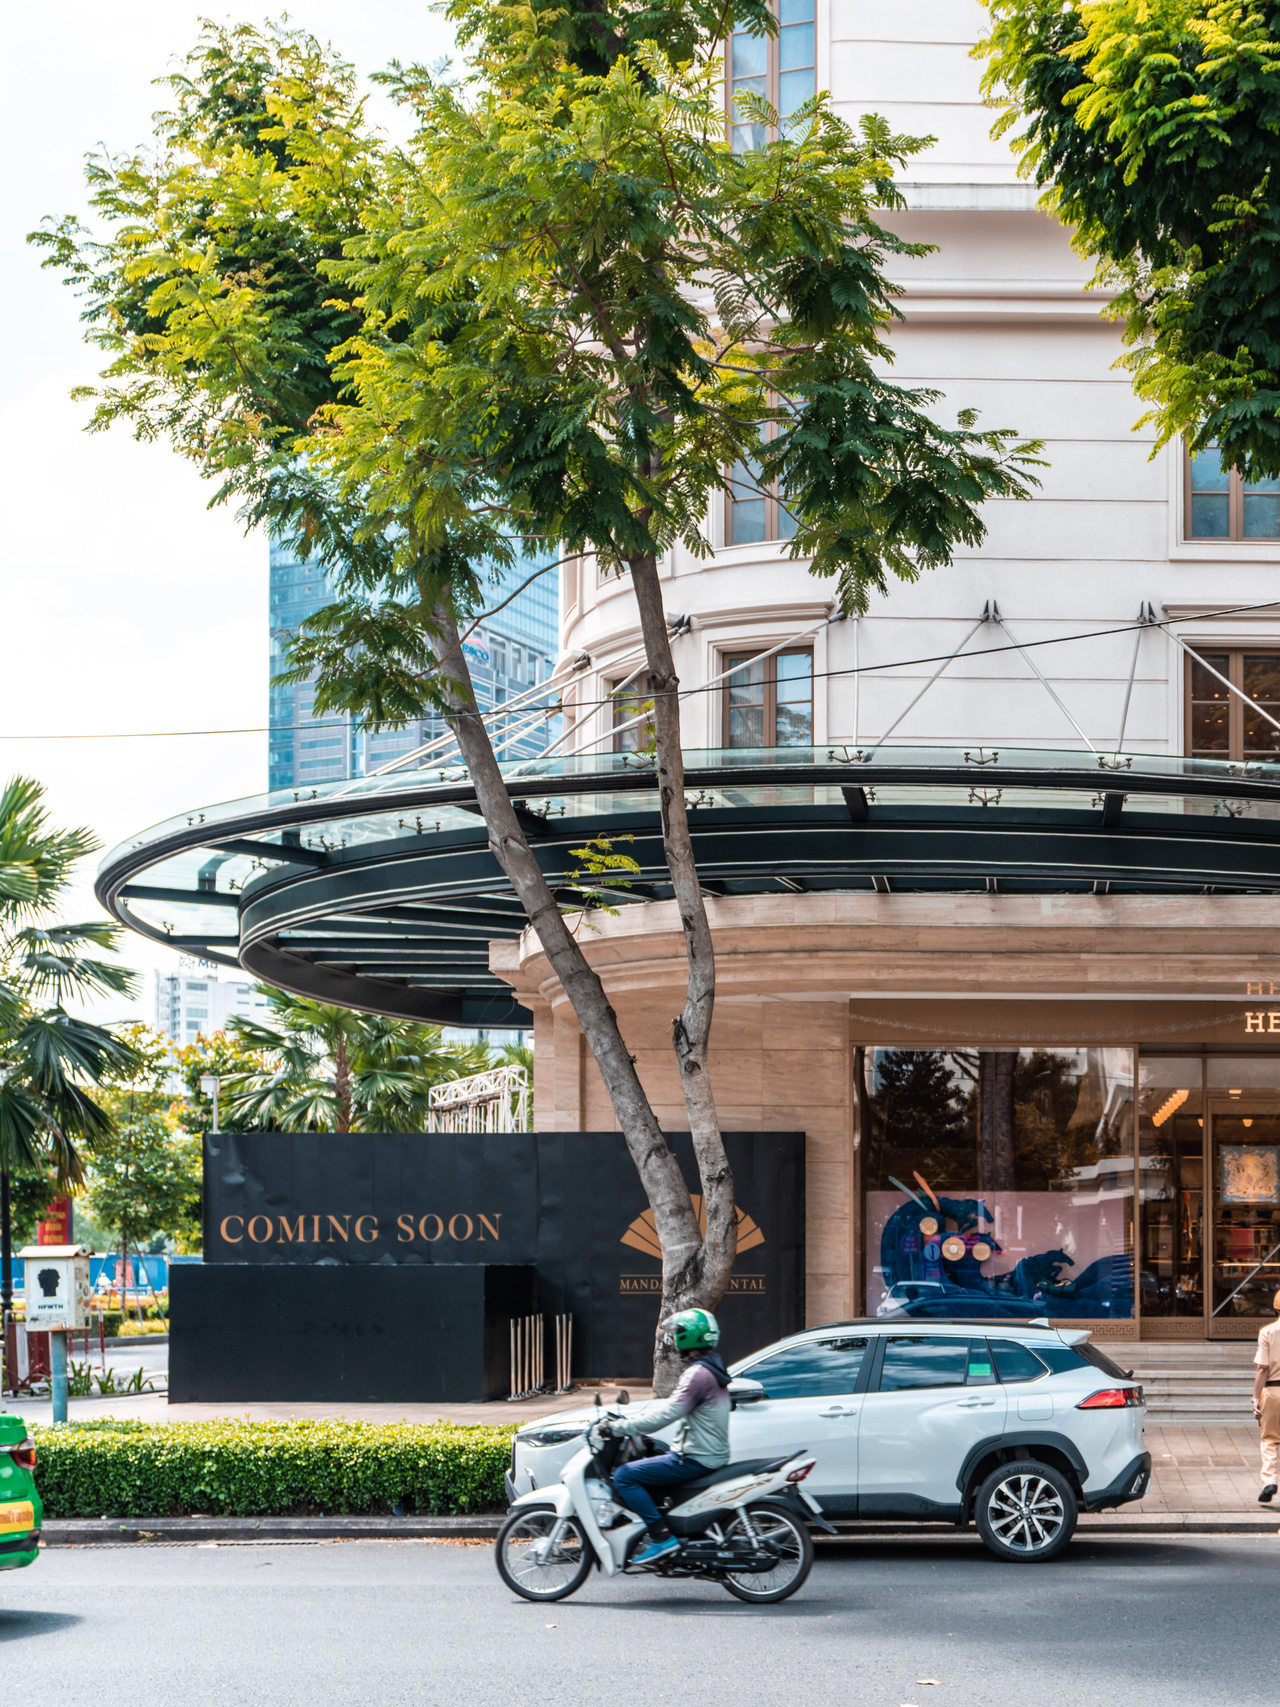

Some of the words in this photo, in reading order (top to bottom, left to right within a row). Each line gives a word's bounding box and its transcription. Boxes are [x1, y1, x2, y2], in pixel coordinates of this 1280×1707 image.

[220, 1215, 379, 1243] COMING
[397, 1213, 502, 1242] SOON
[620, 1279, 663, 1290] MANDA
